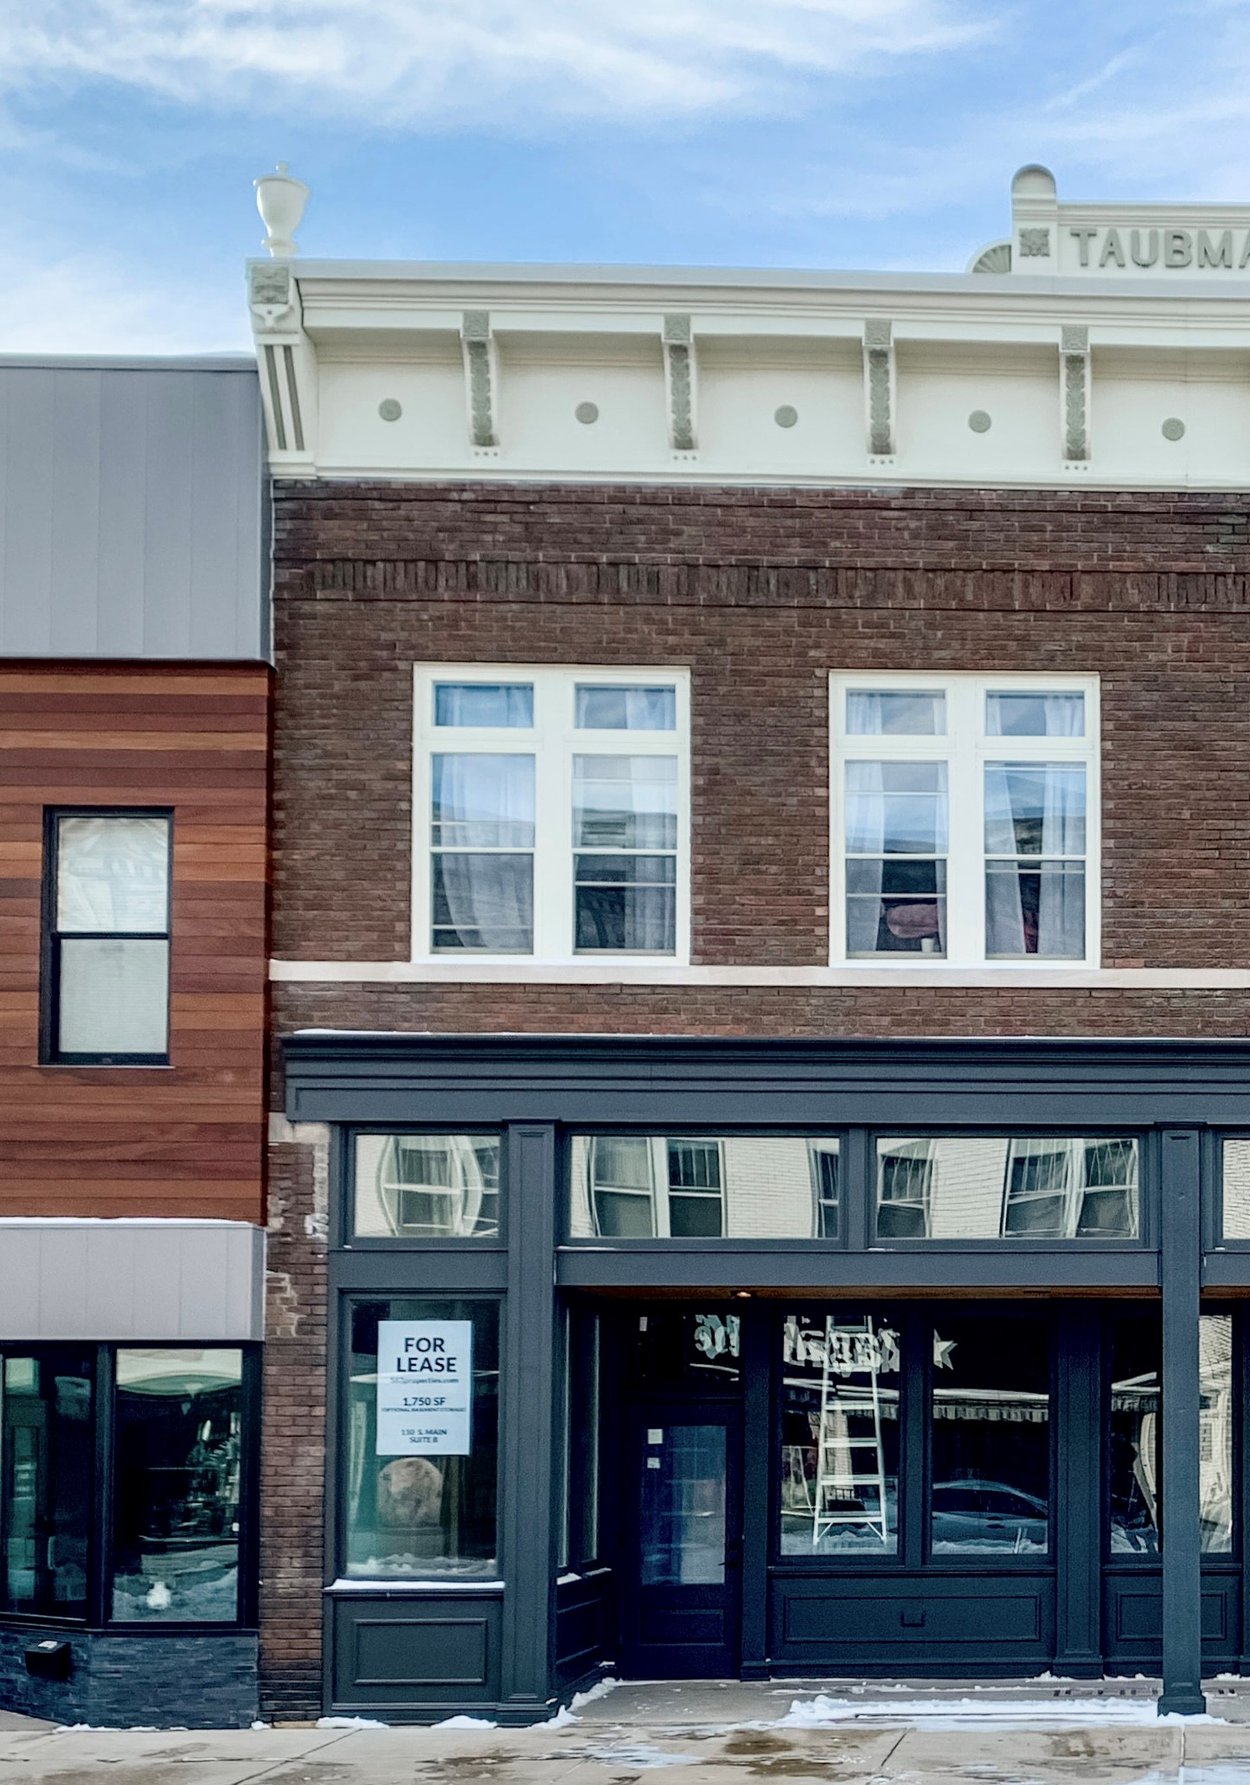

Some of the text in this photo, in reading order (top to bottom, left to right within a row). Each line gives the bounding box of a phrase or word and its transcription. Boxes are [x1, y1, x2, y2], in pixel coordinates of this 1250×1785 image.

[404, 1337, 446, 1353] FOR
[396, 1357, 457, 1373] LEASE
[403, 1396, 447, 1407] 1,750 SF
